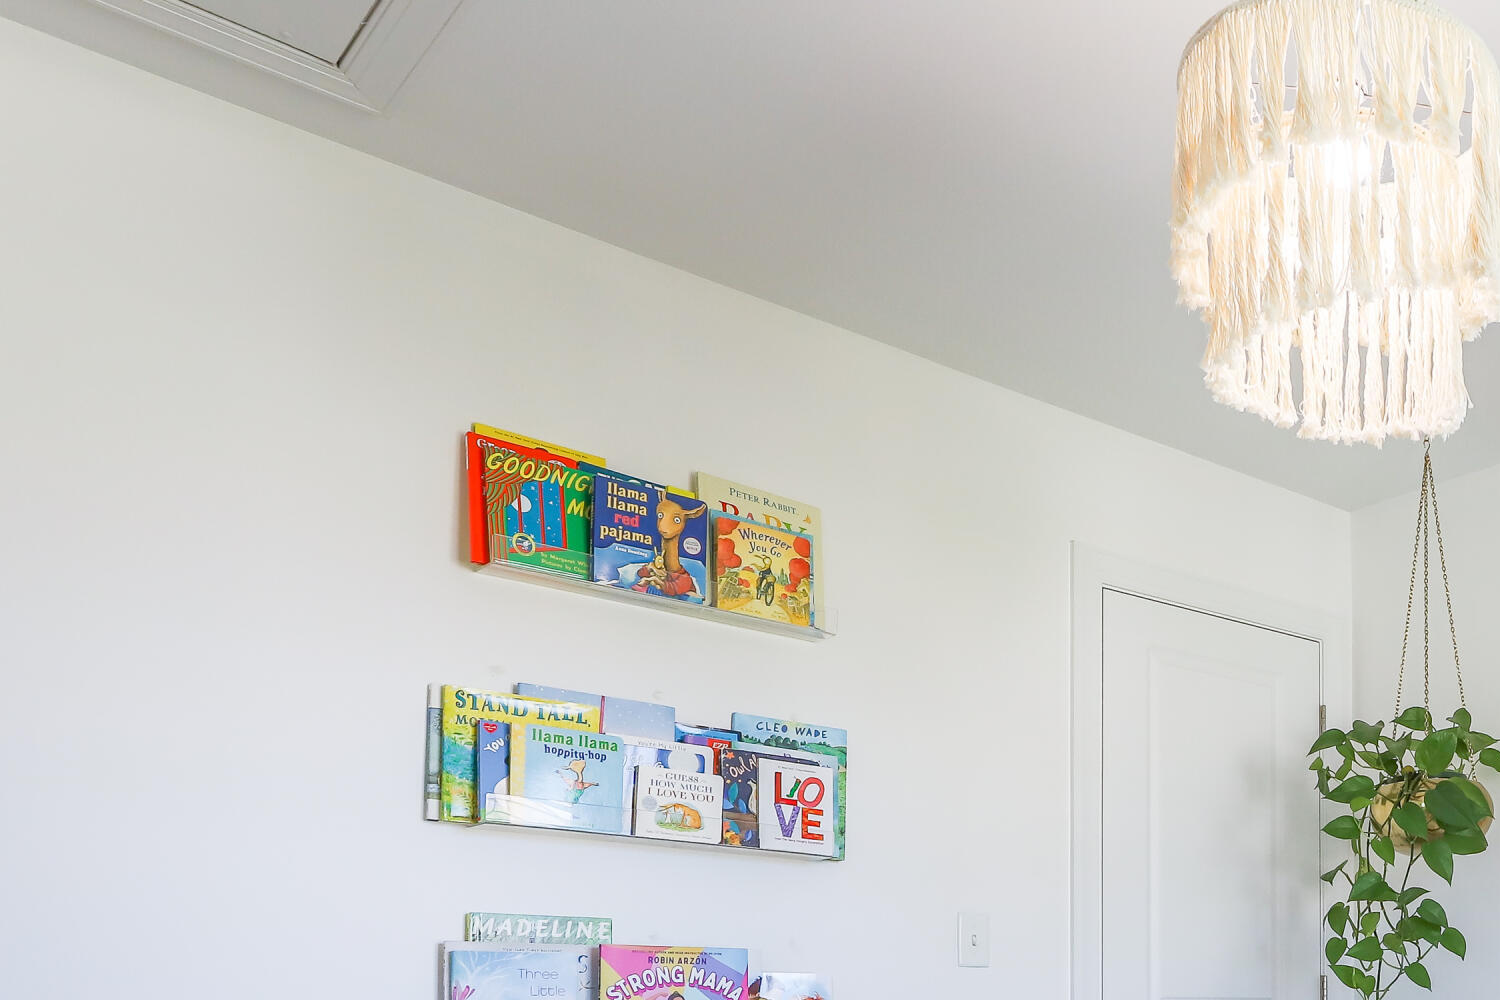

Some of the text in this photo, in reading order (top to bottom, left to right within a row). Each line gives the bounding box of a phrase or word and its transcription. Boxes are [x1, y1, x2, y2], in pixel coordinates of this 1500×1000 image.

[486, 452, 594, 494] GOODNIG
[607, 481, 648, 502] llama
[607, 495, 648, 516] llama
[729, 487, 797, 515] PETER RABBIT
[614, 513, 641, 528] red
[599, 525, 653, 546] pajama
[737, 527, 793, 551] Wherever
[748, 541, 782, 558] You Go
[455, 689, 529, 717] STAND
[756, 721, 828, 738] CLEO WADE
[483, 738, 505, 753] YOU
[532, 728, 573, 746] llama
[578, 734, 619, 752] llama
[544, 744, 607, 762] hoppity-hop
[729, 756, 751, 778] Owl
[650, 779, 713, 794] HOW MUCH
[665, 772, 699, 783] GUESS
[656, 788, 687, 800] LOVE
[690, 793, 715, 803] YOU
[471, 914, 611, 940] MADELINE
[648, 955, 707, 965] ROBIN ARZÓN
[518, 968, 560, 980] Three
[530, 985, 567, 997] Little
